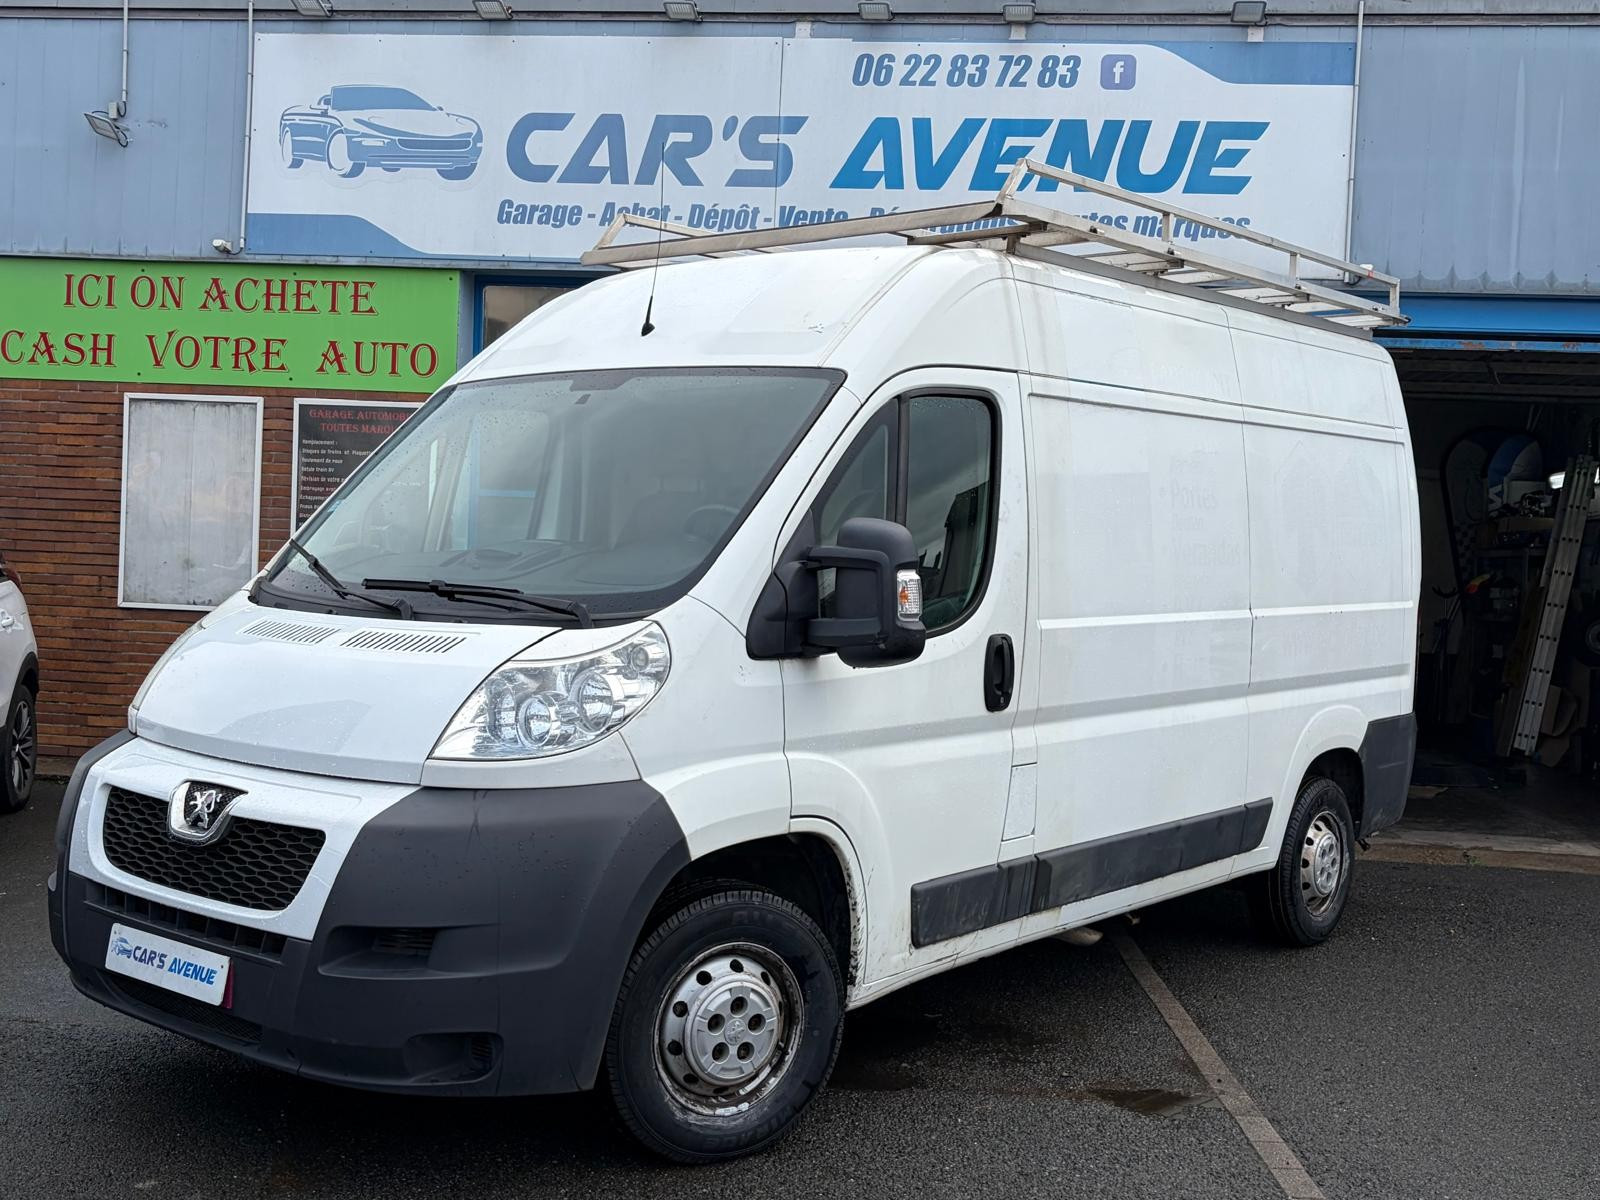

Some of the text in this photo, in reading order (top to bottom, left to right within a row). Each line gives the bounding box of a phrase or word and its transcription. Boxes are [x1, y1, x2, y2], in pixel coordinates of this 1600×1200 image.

[852, 53, 1082, 88] 06 22 83 72 83
[506, 112, 1271, 195] CAR'S AVENUE
[497, 199, 583, 228] Garage
[687, 203, 760, 232] Dépôt
[779, 205, 849, 229] Vente
[64, 273, 379, 316] ICI ON ACHETE
[0, 329, 439, 379] CASH VOTRE AUTO
[309, 409, 354, 420] GARAGE
[320, 423, 359, 433] TOUTES
[133, 945, 218, 985] CAR'S AVENUE
